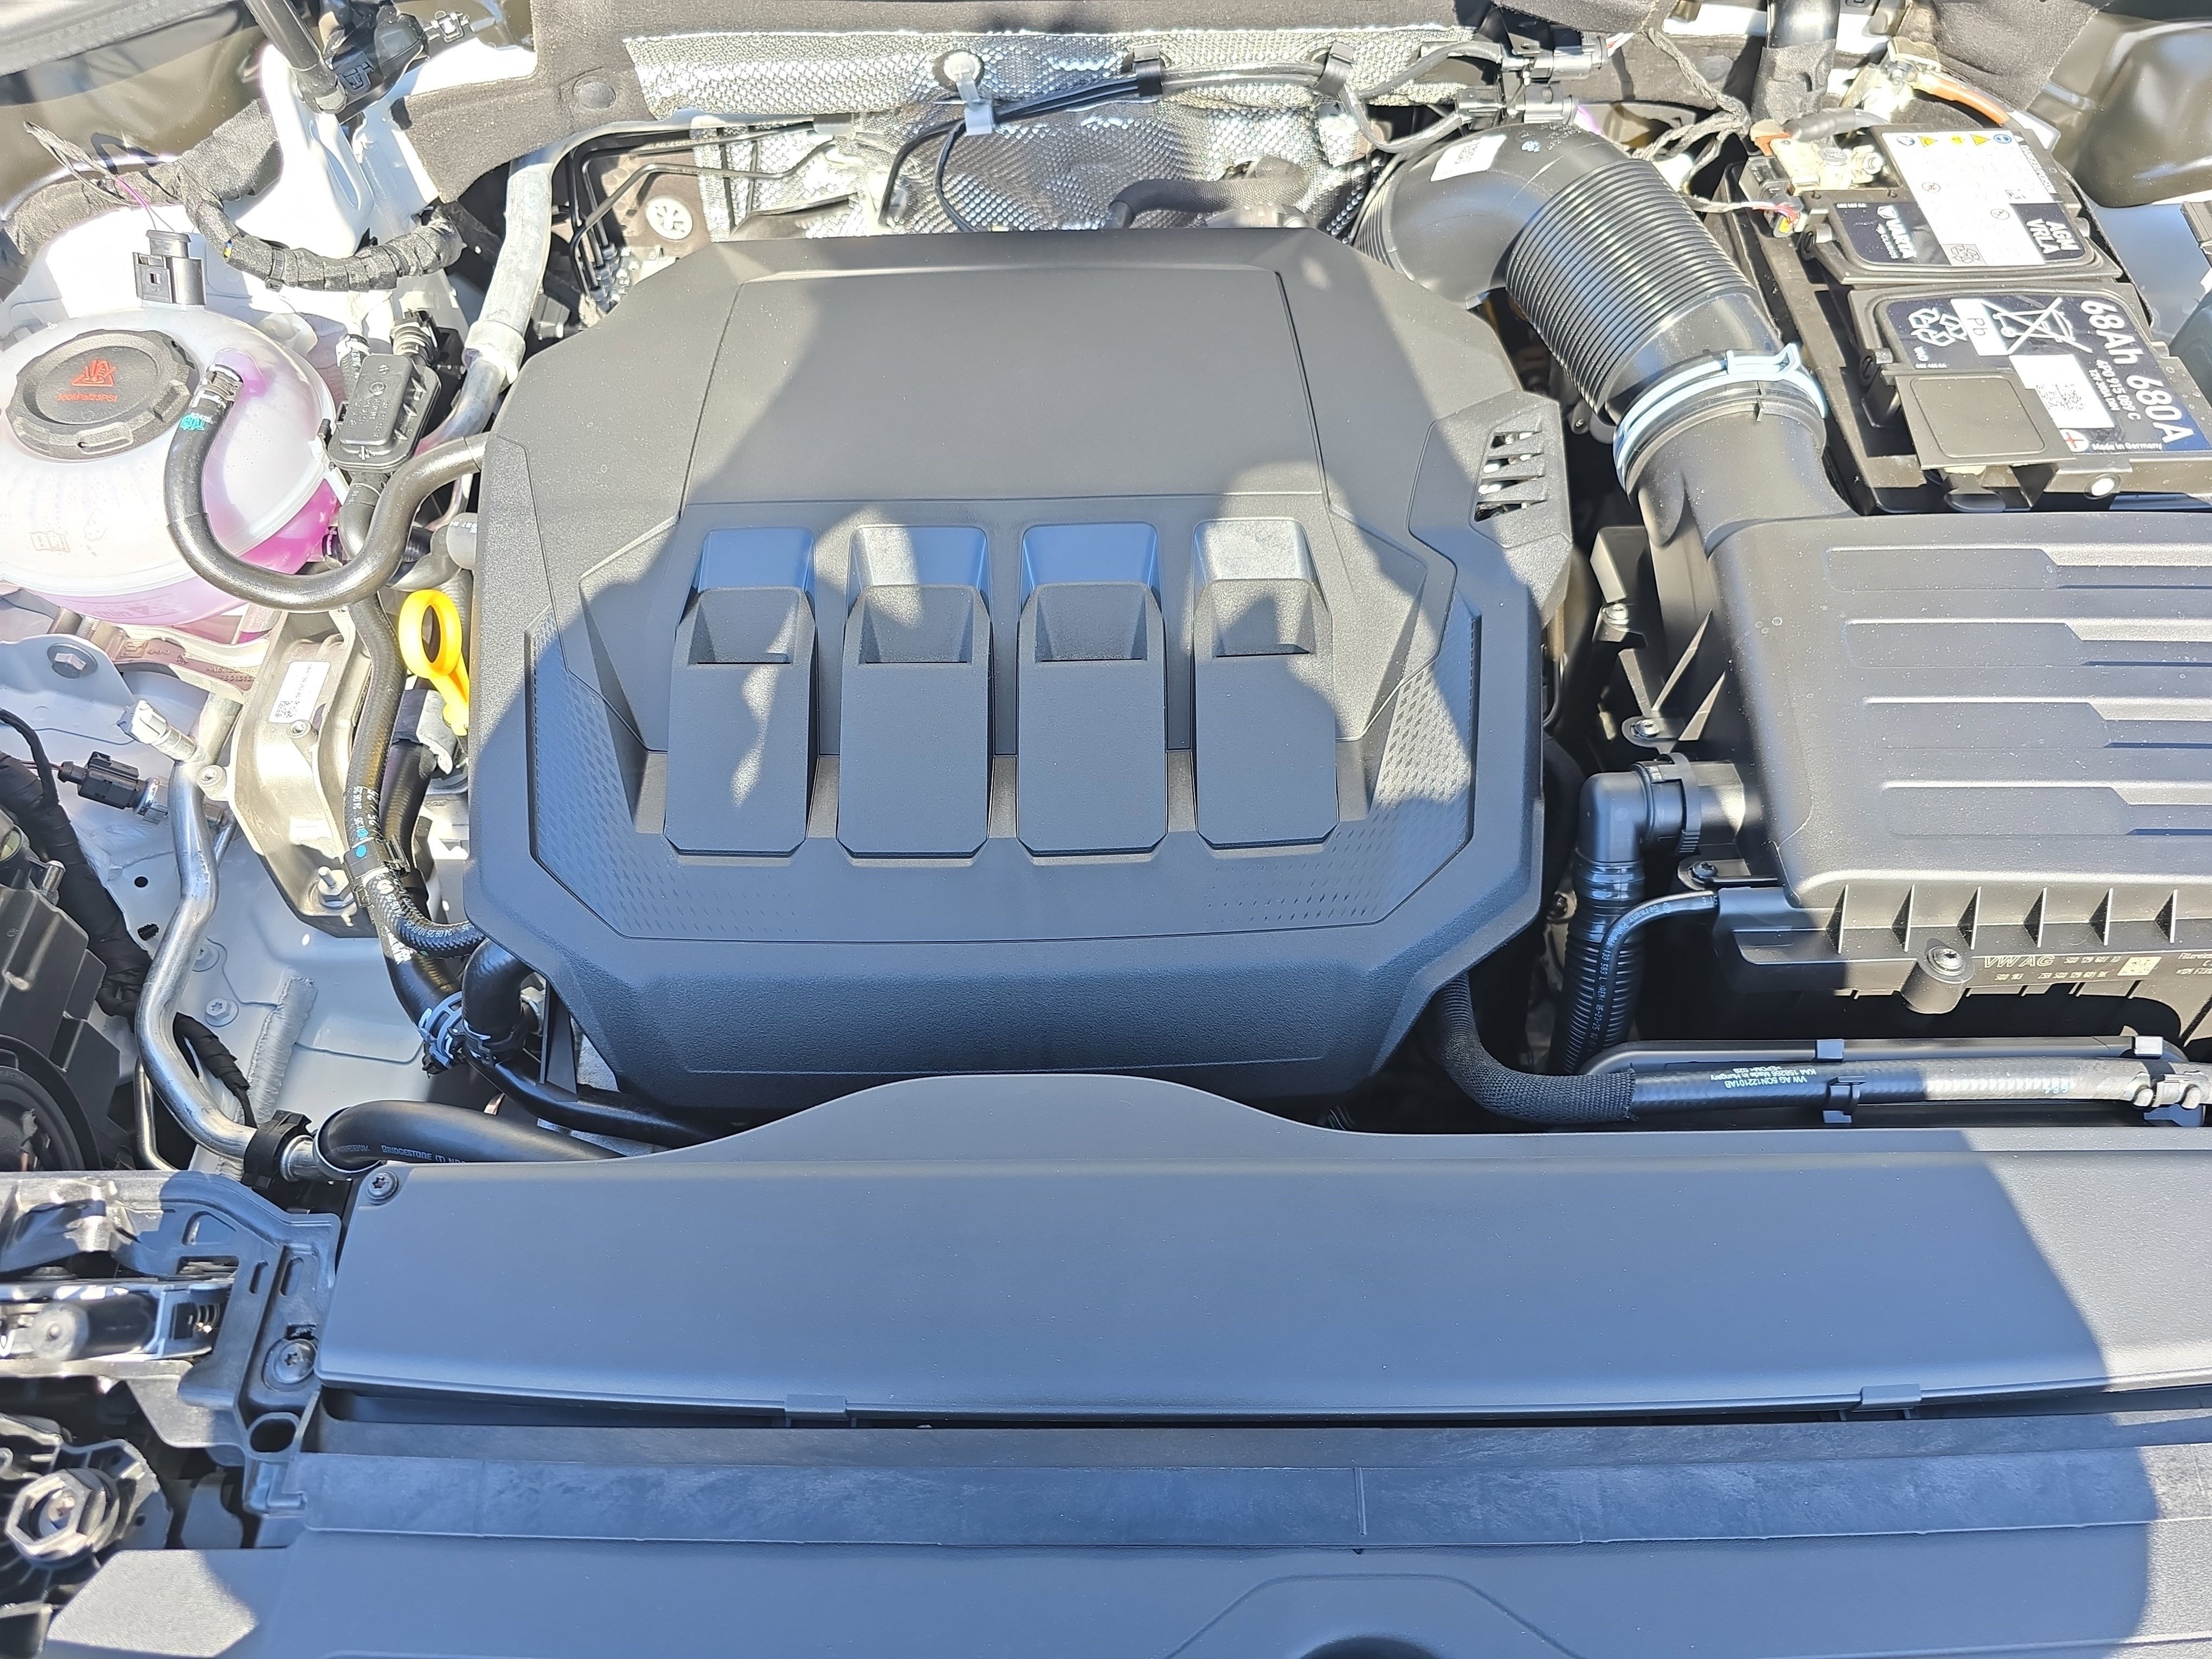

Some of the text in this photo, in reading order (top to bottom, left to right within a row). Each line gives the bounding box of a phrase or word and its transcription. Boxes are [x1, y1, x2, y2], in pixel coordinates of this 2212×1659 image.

[1886, 218, 1918, 259] VARTA
[2027, 218, 2060, 254] VRLA
[2045, 221, 2081, 251] AGM
[1966, 318, 1989, 337] Pb
[2081, 300, 2194, 443] 68Ah 680A
[2096, 359, 2141, 421] 4P0 915 089 C
[2091, 443, 2114, 451] Made
[2125, 442, 2163, 452] Germany
[1984, 955, 2056, 968] VW AG
[381, 1144, 433, 1161] BRIDGESTONE
